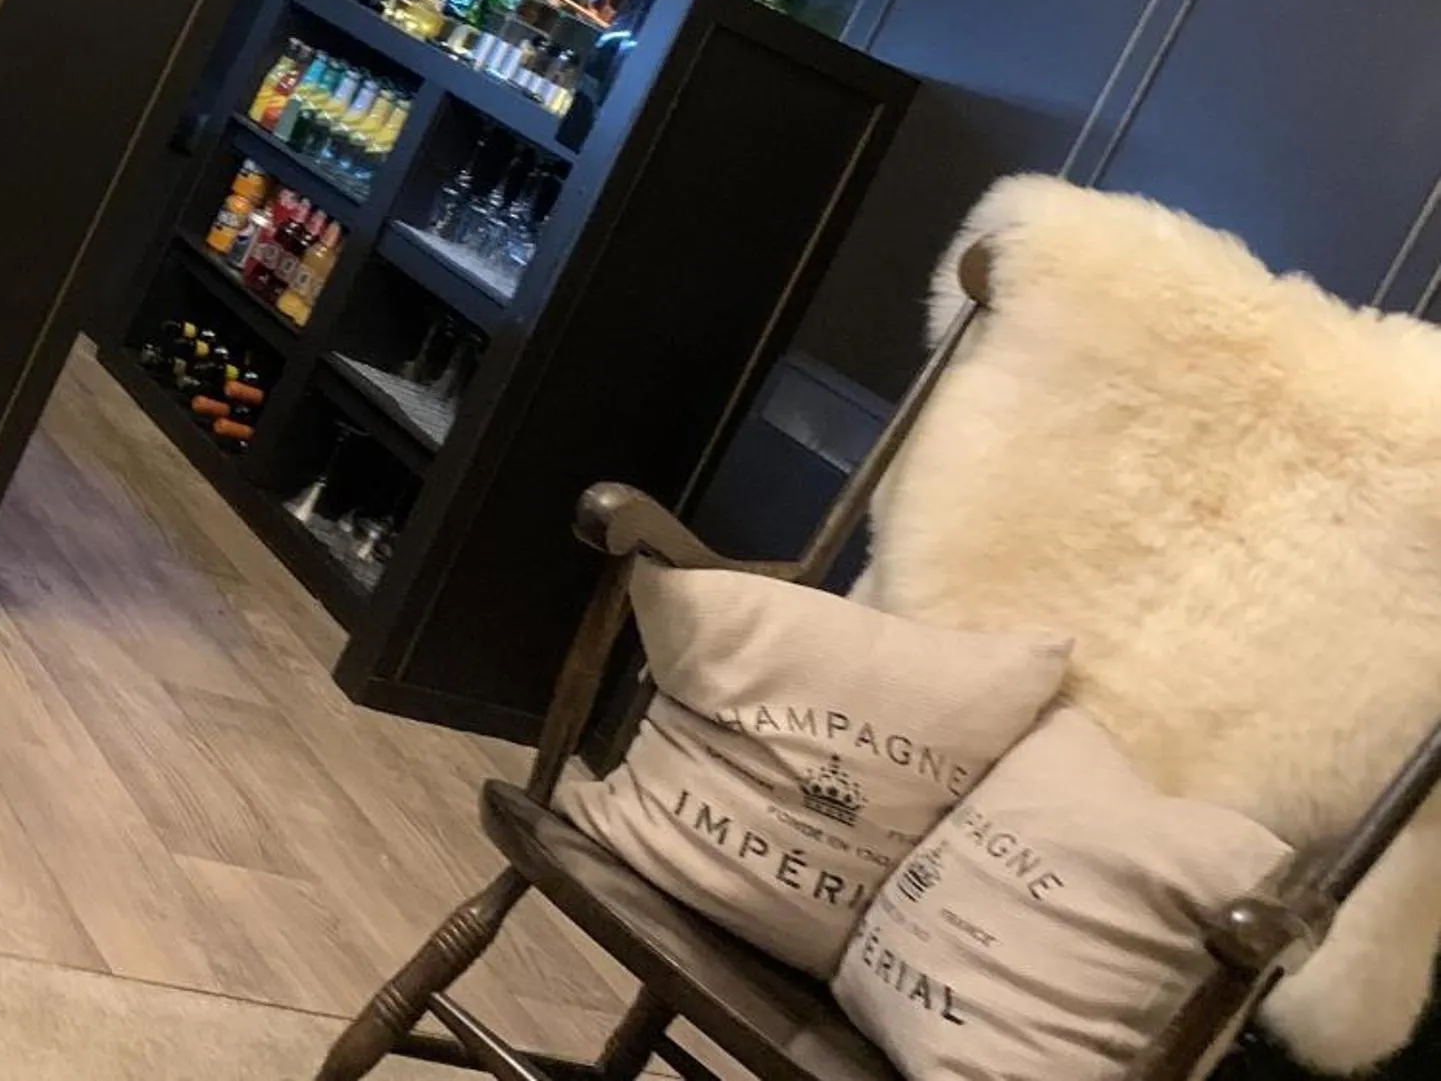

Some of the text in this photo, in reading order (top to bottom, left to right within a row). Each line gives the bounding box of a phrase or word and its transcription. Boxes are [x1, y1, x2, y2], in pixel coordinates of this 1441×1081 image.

[713, 705, 969, 796] HAMPAGNE
[675, 789, 864, 909] IMPÉRI
[861, 926, 965, 1026] ÉRIAL
